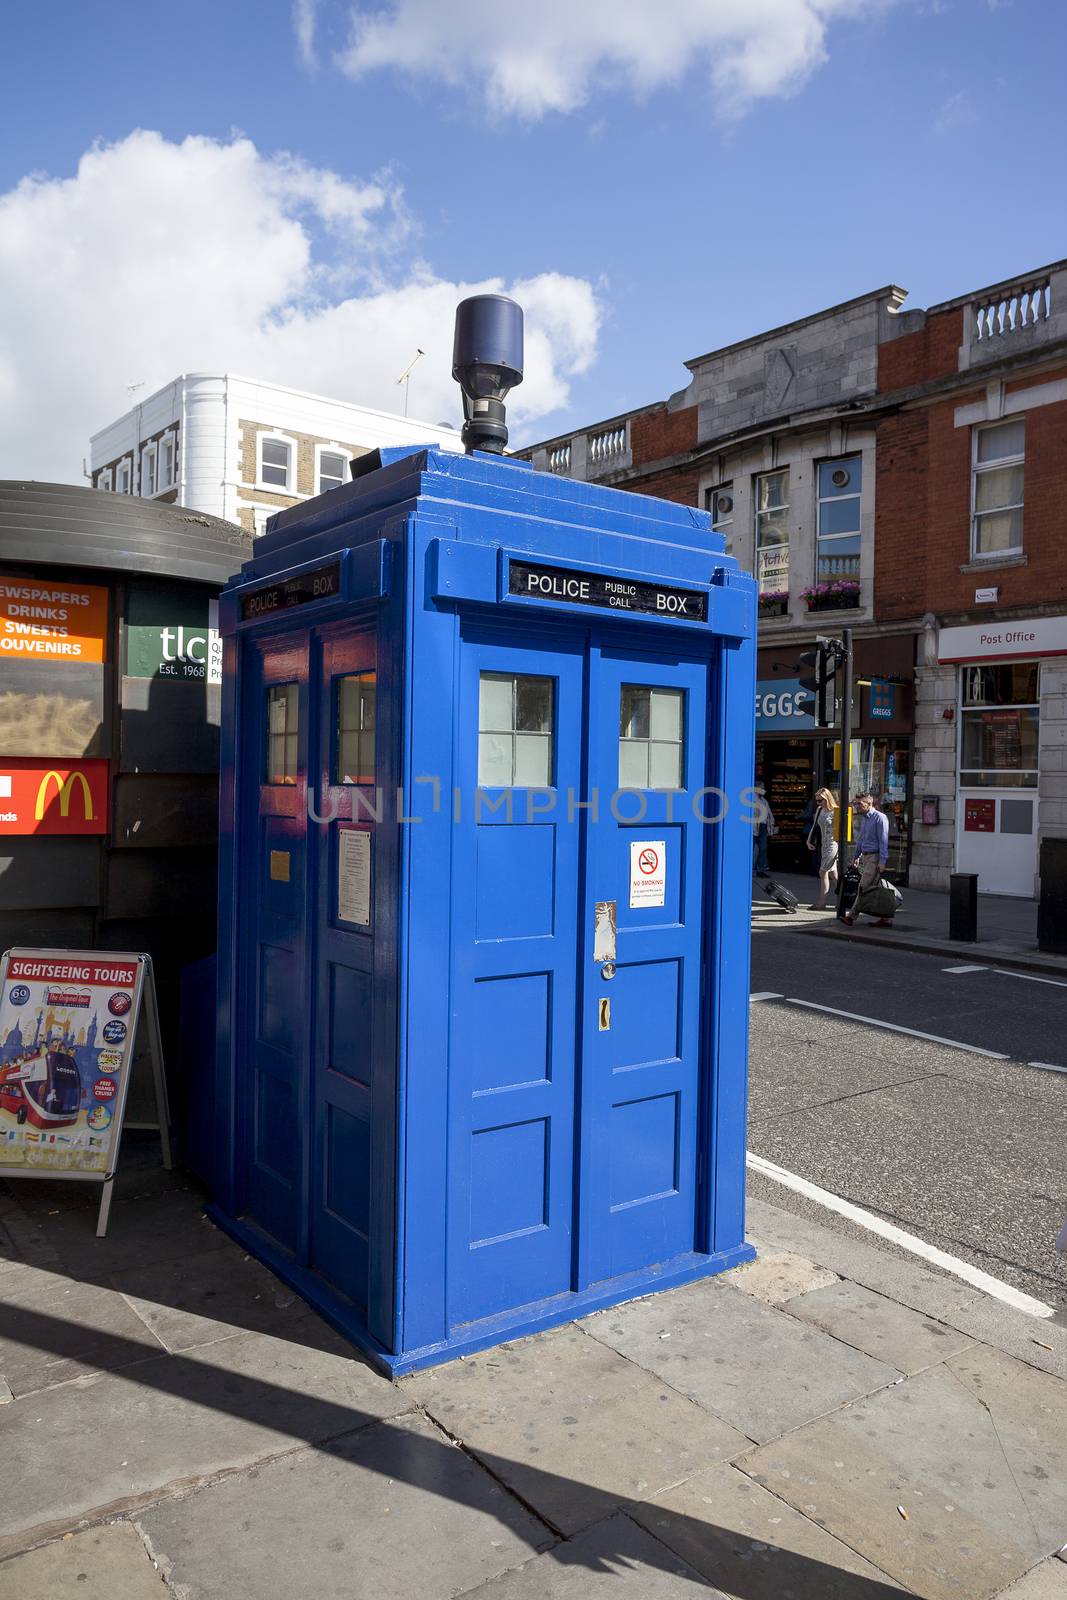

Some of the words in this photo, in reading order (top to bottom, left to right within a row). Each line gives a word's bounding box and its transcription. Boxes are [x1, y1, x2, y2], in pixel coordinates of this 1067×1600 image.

[250, 592, 278, 612] POLICE
[313, 575, 334, 595] BOX
[528, 574, 590, 598] POLICE
[656, 594, 688, 613] BOX
[605, 582, 636, 596] PUBLIC
[609, 597, 632, 608] CALL
[7, 603, 68, 620] DRINKS
[5, 620, 68, 638] SWEETS
[160, 626, 206, 664] tlc
[980, 634, 1002, 645] Post
[1005, 632, 1036, 643] Office
[159, 663, 178, 675] Est.
[183, 665, 205, 678] 1968
[872, 706, 892, 716] GREGGS
[641, 879, 664, 887] SMOKING
[12, 962, 91, 980] SIGHTSEEING
[94, 968, 134, 983] TOURS
